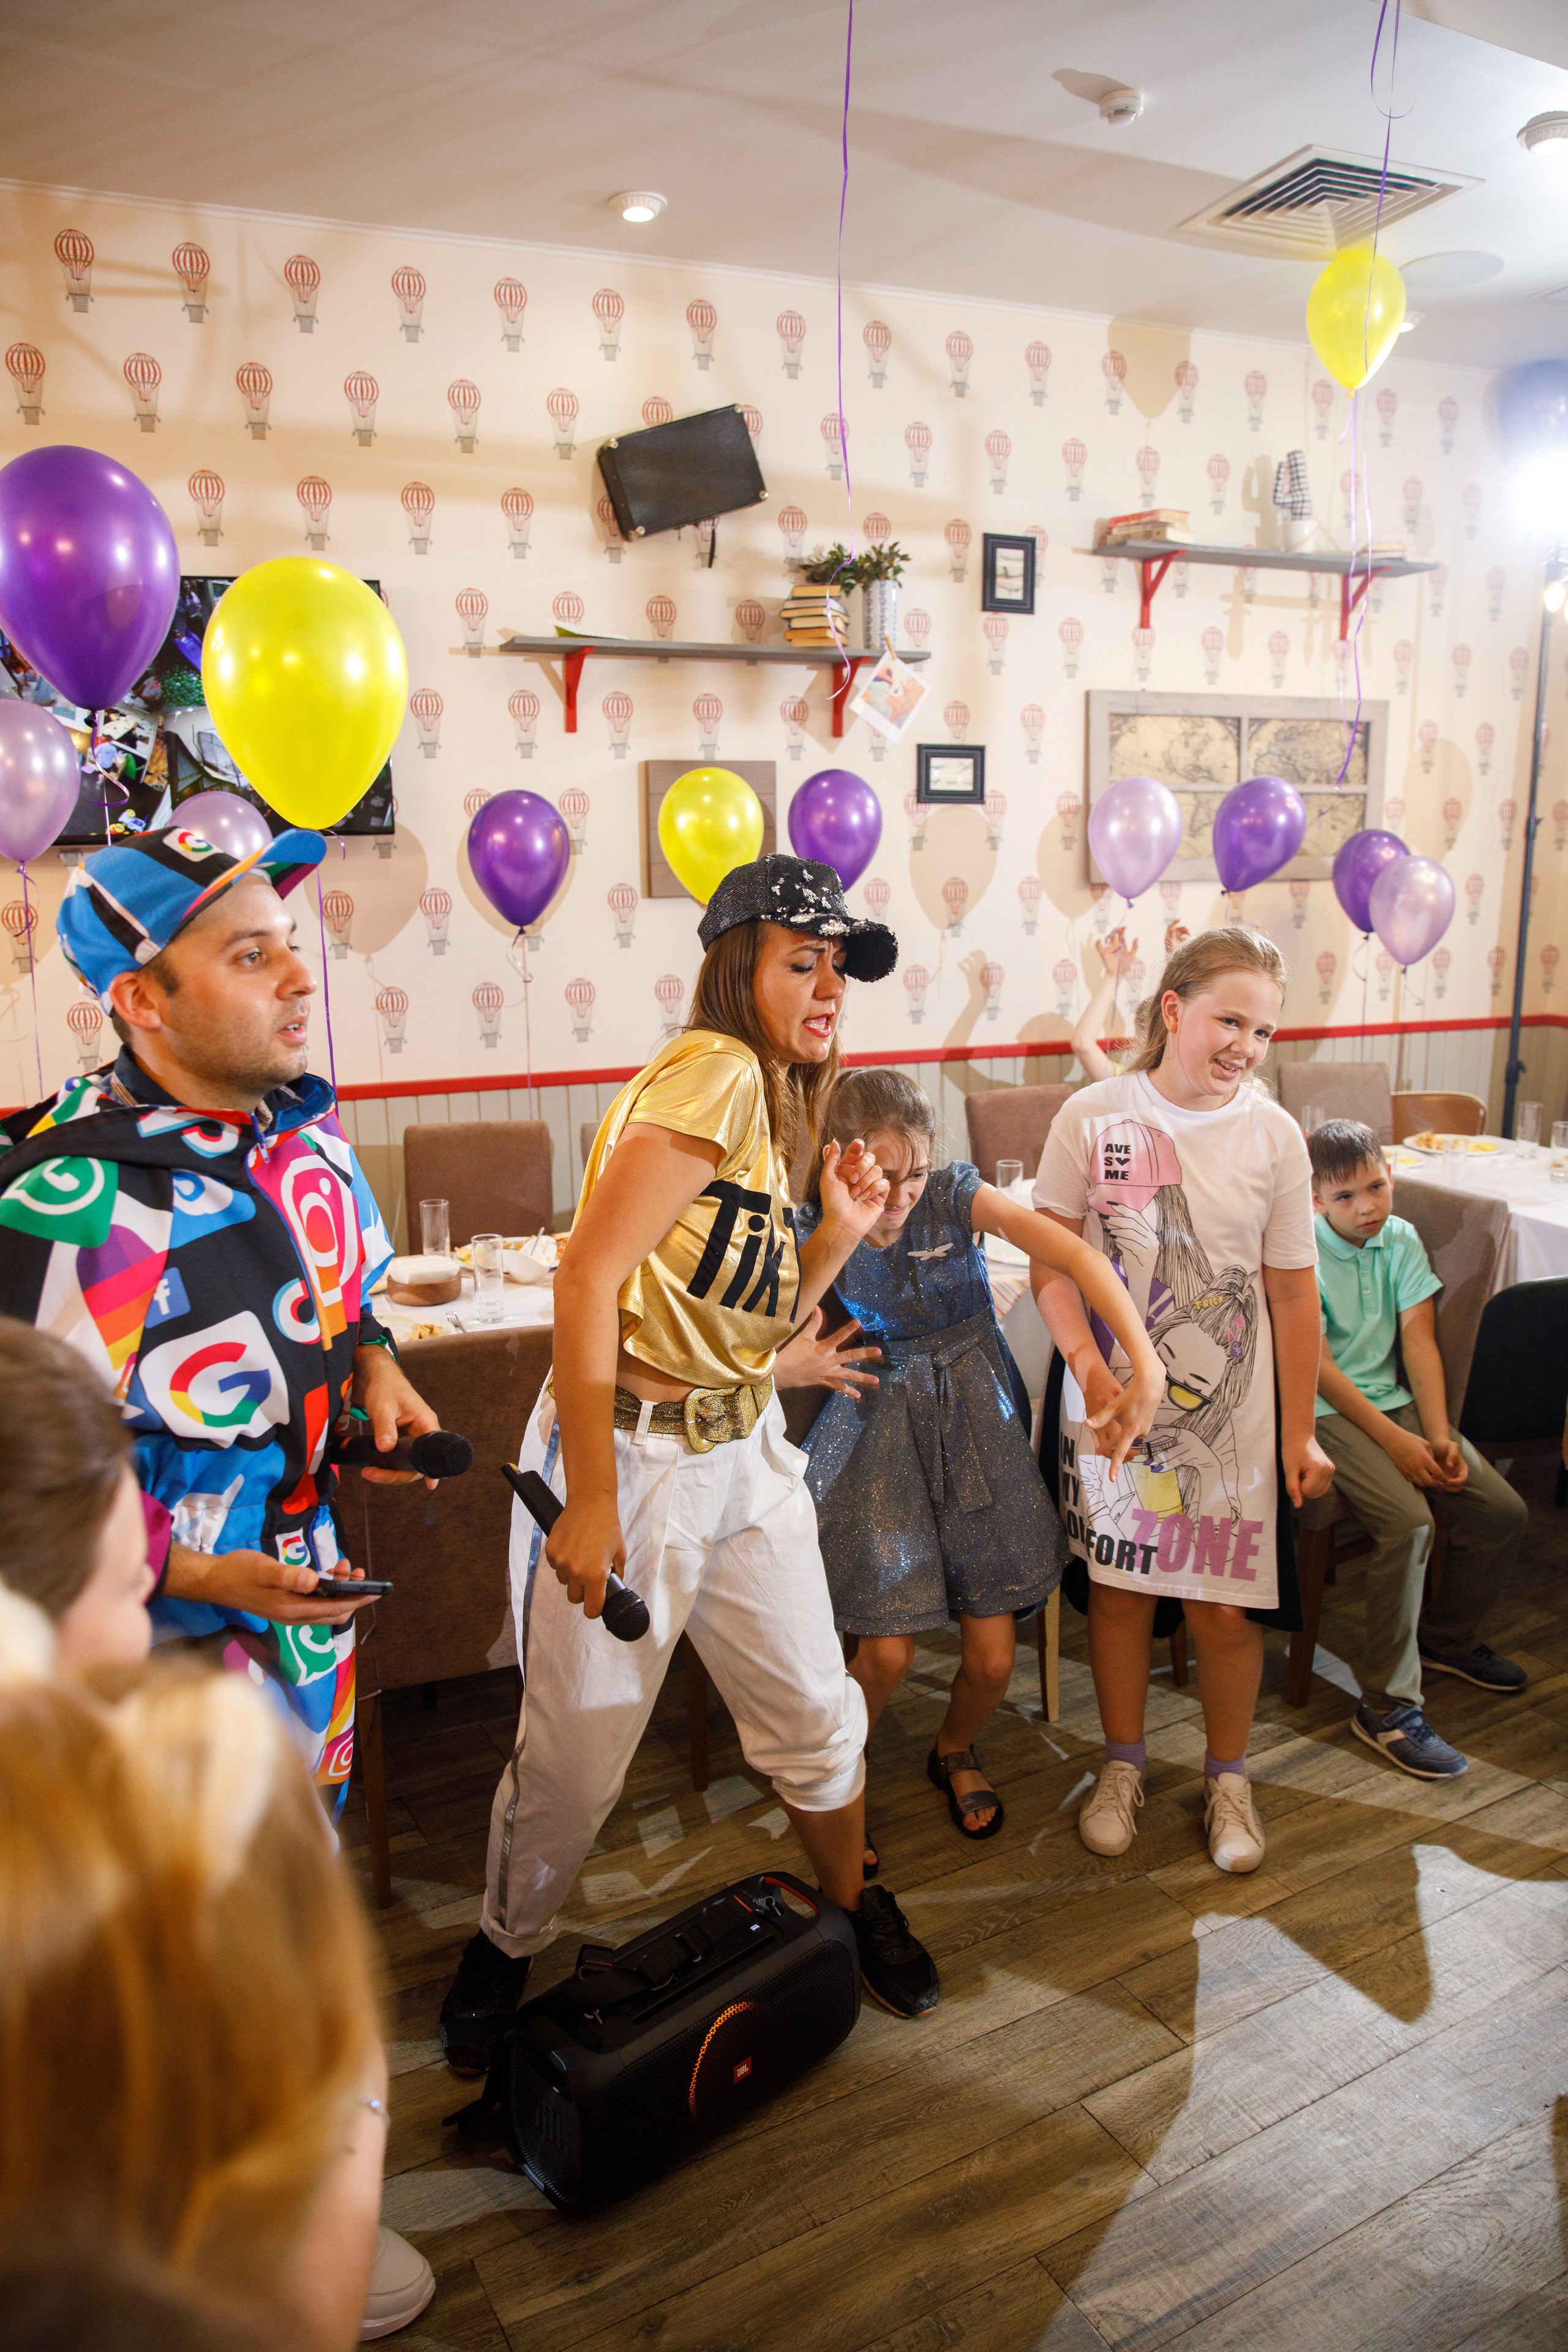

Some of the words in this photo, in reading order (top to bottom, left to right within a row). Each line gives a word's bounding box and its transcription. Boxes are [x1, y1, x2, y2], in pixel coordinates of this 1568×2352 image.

[1104, 1143, 1131, 1154] AVE
[1104, 1170, 1129, 1180] ME
[1194, 1295, 1224, 1310] TRICK
[1060, 1431, 1075, 1469] IN
[1123, 1508, 1264, 1581] ZONE
[737, 2064, 748, 2077] JBL
[530, 2096, 569, 2158] JBL
